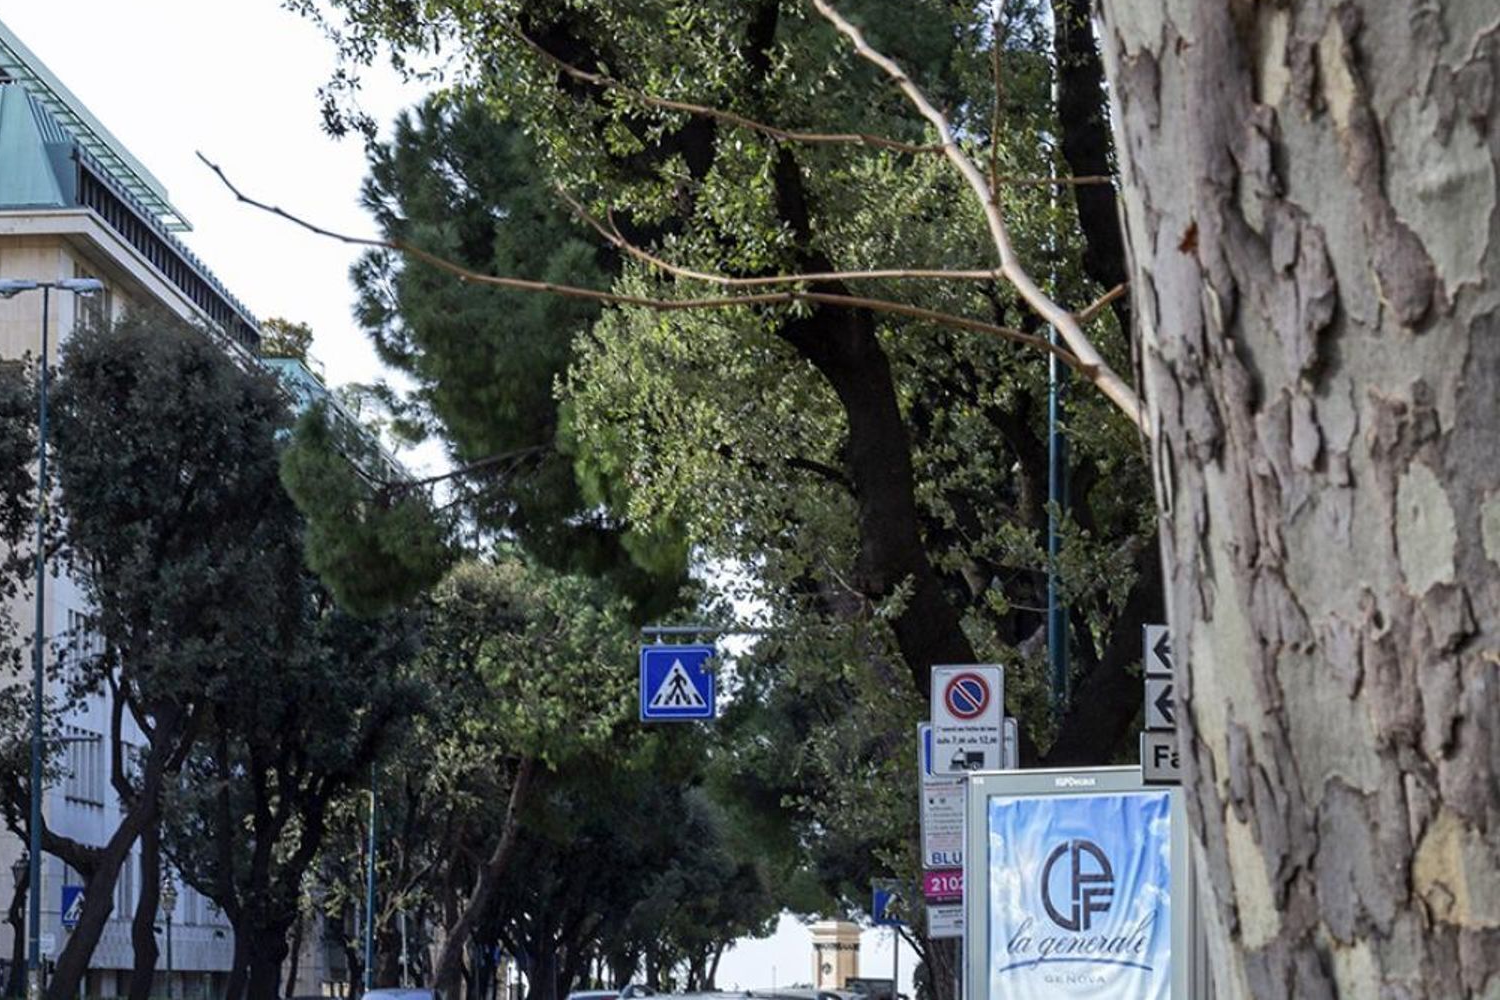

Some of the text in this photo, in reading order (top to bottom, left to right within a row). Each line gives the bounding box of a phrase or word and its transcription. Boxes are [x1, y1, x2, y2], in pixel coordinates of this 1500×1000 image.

[1007, 909, 1158, 970] la generale
[1044, 974, 1107, 984] GENOVA
